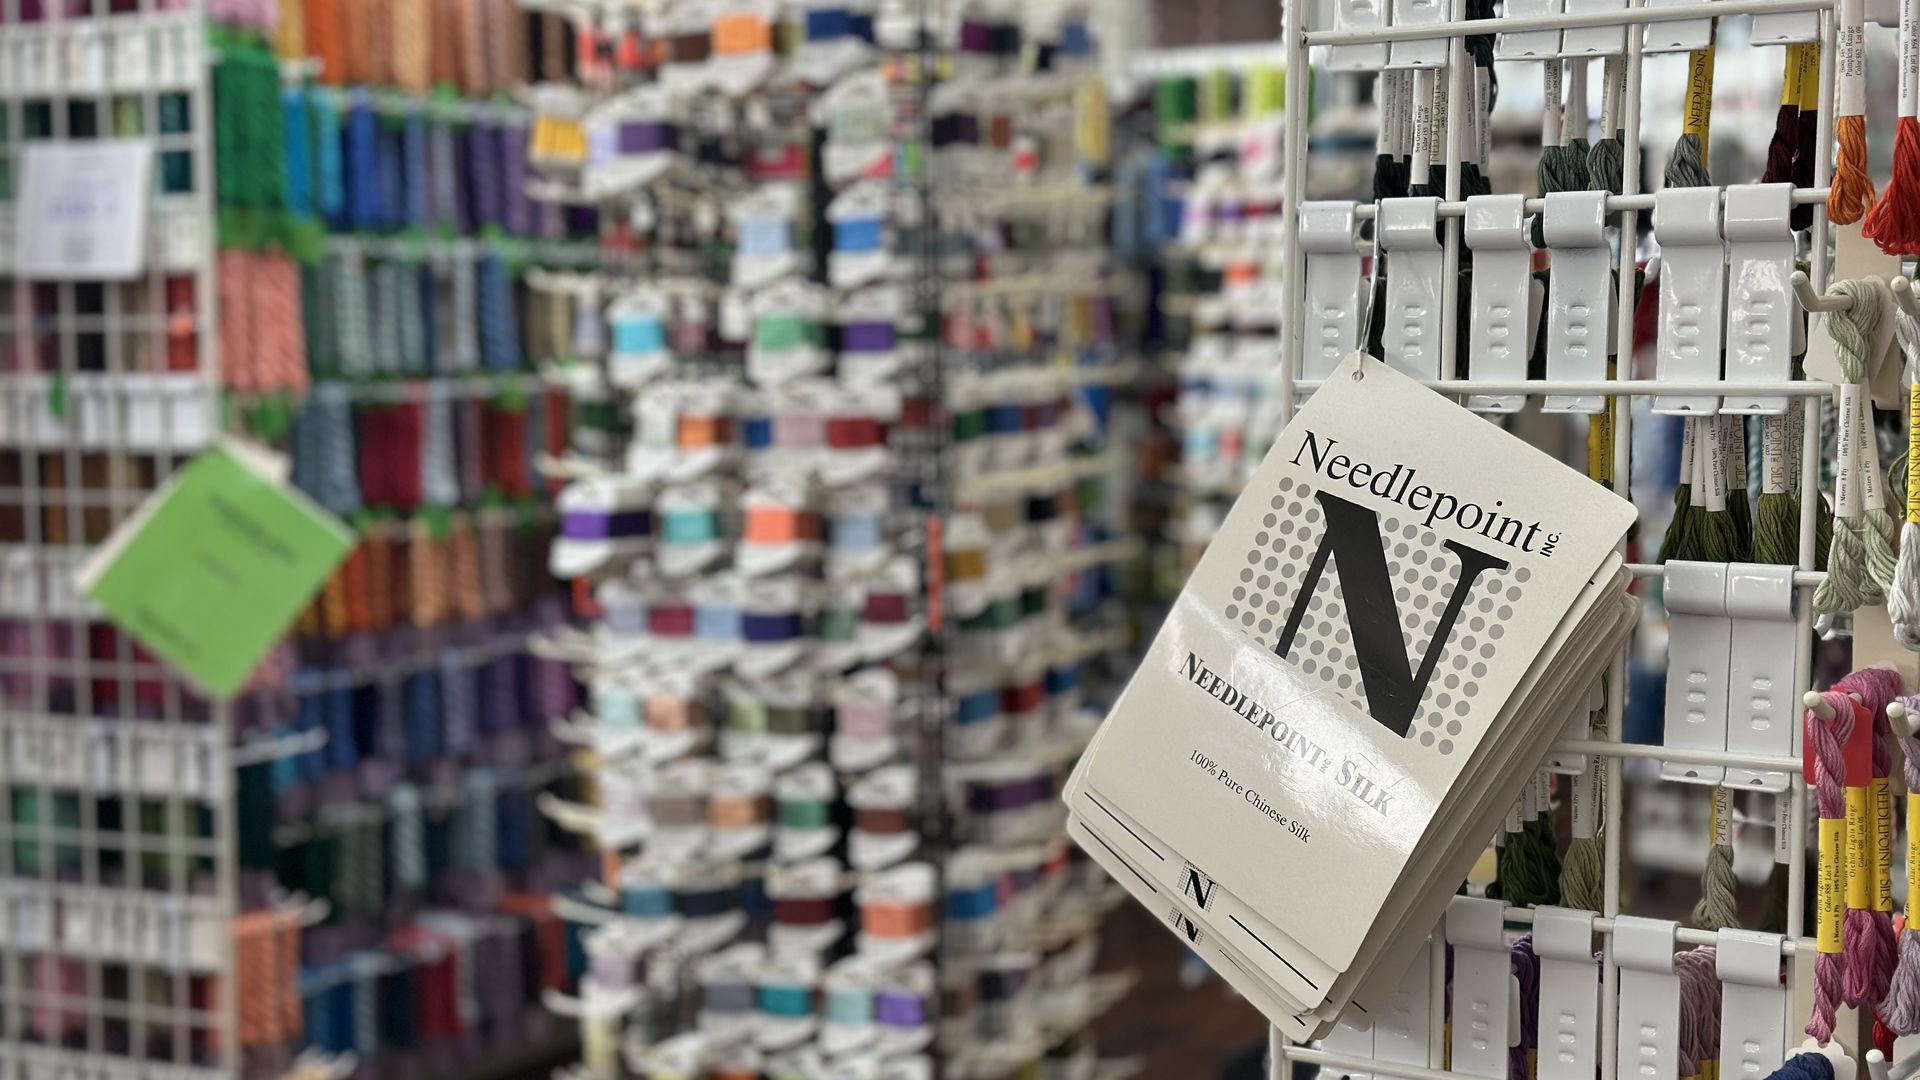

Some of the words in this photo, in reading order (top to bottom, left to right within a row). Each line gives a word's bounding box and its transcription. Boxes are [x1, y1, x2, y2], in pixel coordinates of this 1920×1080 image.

[1846, 25, 1854, 46] Range
[1855, 26, 1863, 34] 09
[1855, 35, 1863, 44] Lot
[1846, 47, 1854, 76] Pumpkin
[1855, 60, 1863, 76] Color
[1770, 416, 1782, 458] EPOINT
[1770, 466, 1784, 491] SILK
[1288, 429, 1543, 553] Needlepoint
[1539, 531, 1563, 558] INC.
[1273, 490, 1509, 739] N
[1178, 651, 1327, 768] NEEDLEPOINT
[1333, 758, 1395, 818] SILK
[1189, 750, 1217, 776] 100%
[1217, 769, 1243, 795] Pure
[1244, 789, 1288, 826] Chinese
[1287, 820, 1312, 844] Silk
[1849, 805, 1857, 826] Range
[1877, 783, 1890, 867] NEEDLEPOINT
[1715, 818, 1728, 842] SILK
[1849, 828, 1857, 850] Lights
[1880, 879, 1891, 906] SILK
